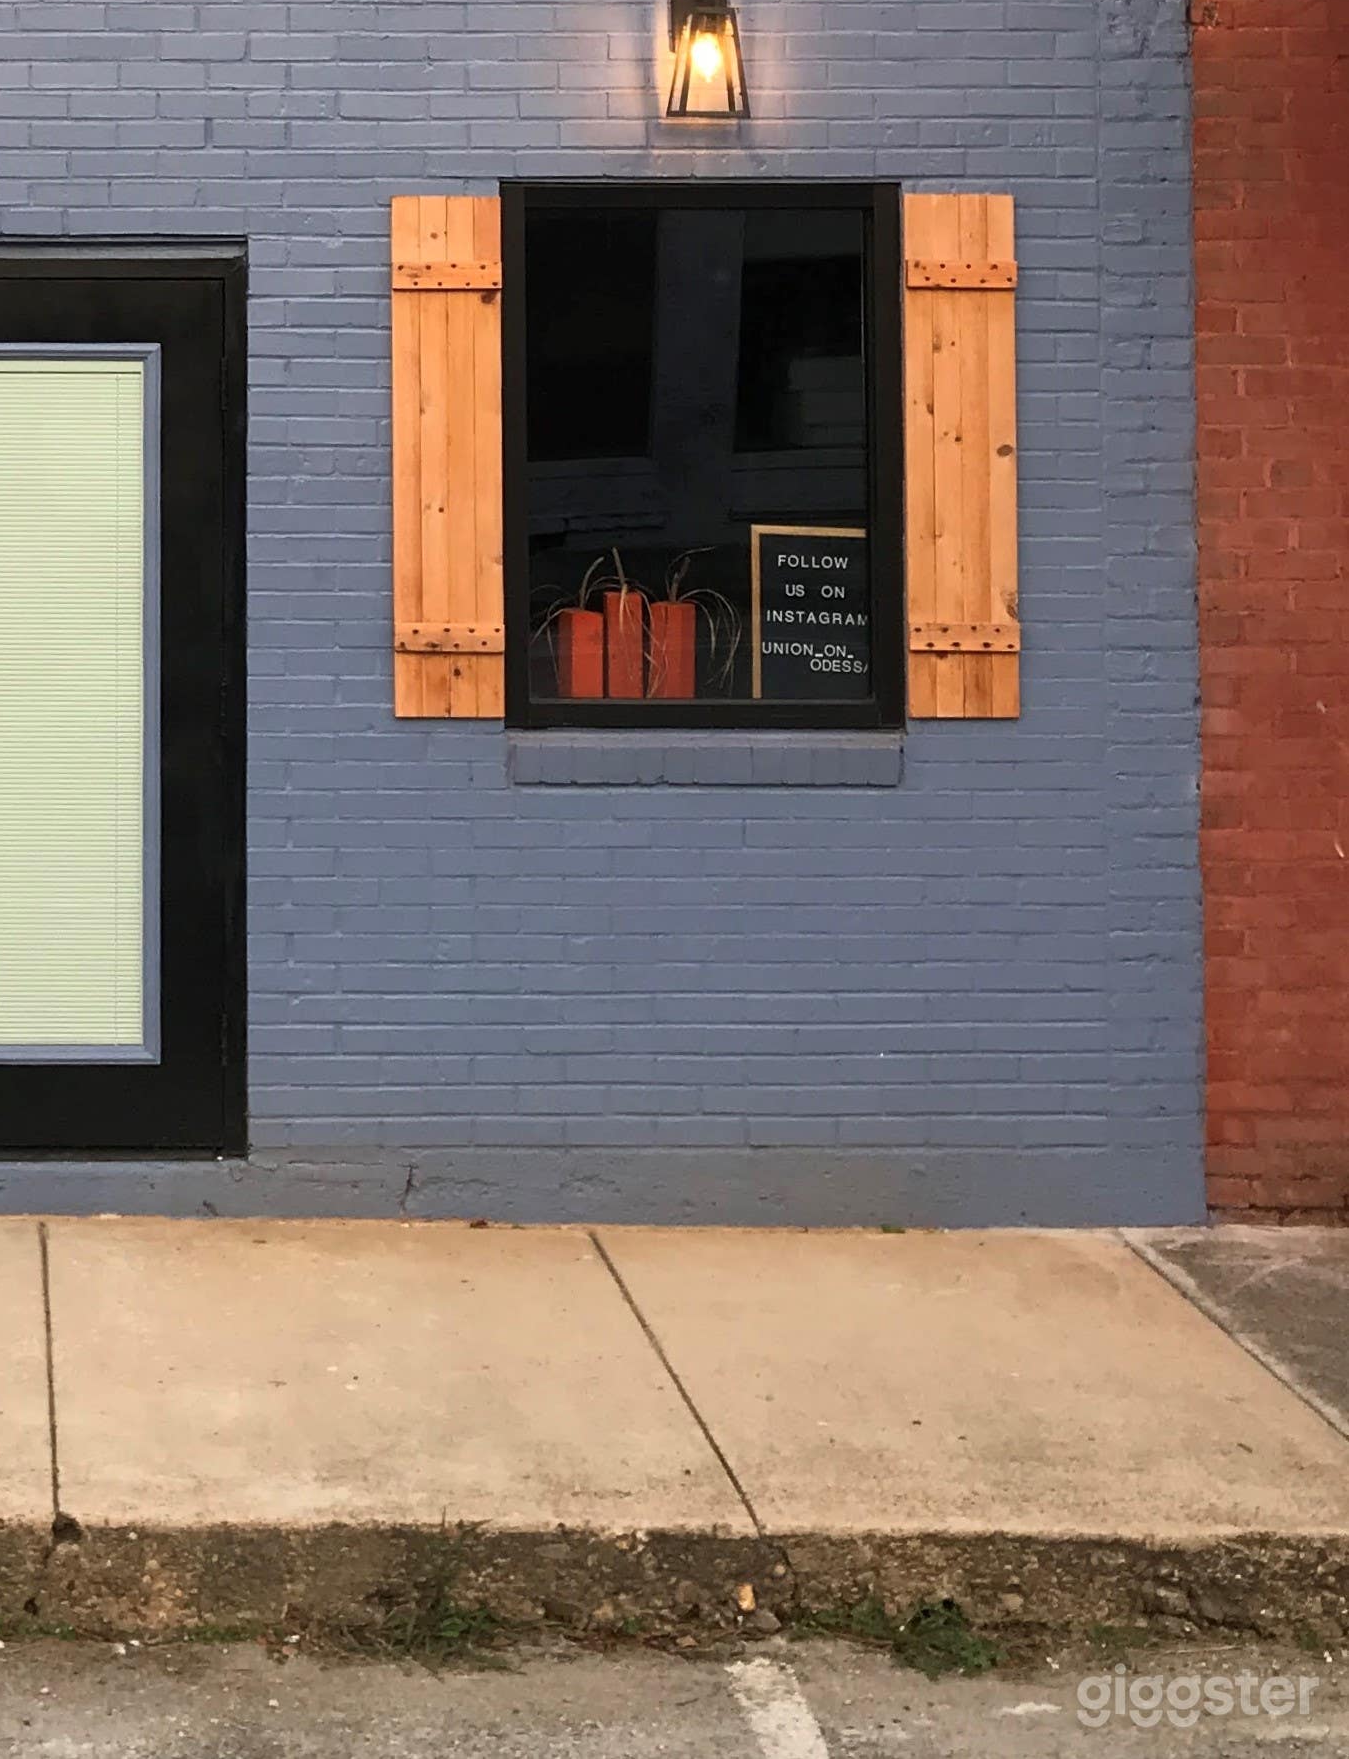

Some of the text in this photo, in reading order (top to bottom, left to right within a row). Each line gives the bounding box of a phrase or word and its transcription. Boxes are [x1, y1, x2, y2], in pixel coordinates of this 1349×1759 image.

[777, 554, 849, 569] FOLLOW
[785, 584, 846, 599] US ON
